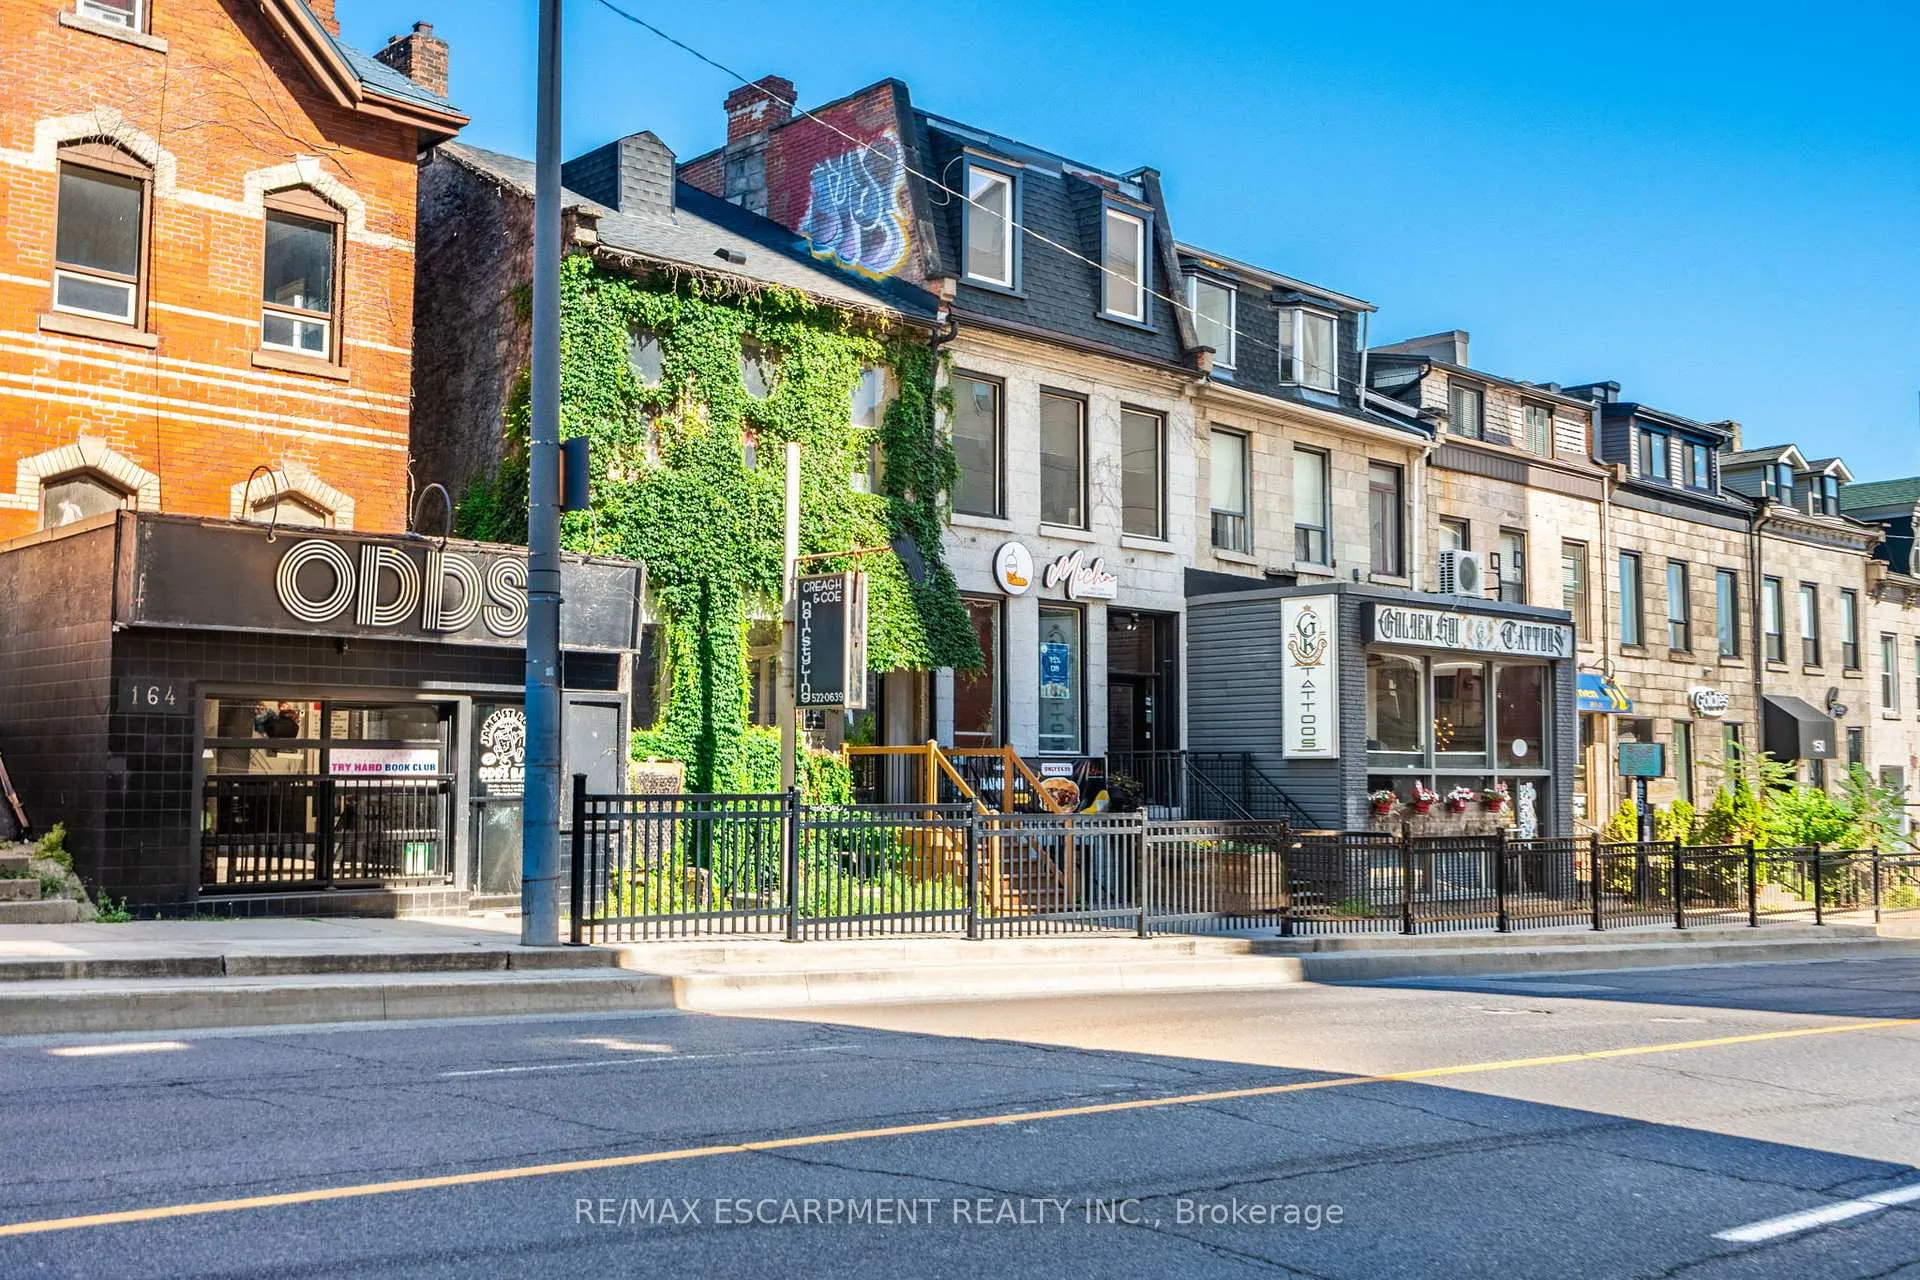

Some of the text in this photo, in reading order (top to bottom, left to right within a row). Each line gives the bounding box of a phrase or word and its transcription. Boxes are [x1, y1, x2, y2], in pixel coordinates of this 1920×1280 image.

[276, 538, 528, 638] ODDS
[802, 578, 843, 593] CREAGH
[821, 590, 842, 603] COE
[132, 686, 176, 705] 164
[1301, 667, 1316, 749] TATTOOS
[480, 710, 501, 747] JAMES
[332, 763, 436, 772] TRY HARD BOOK CLUB
